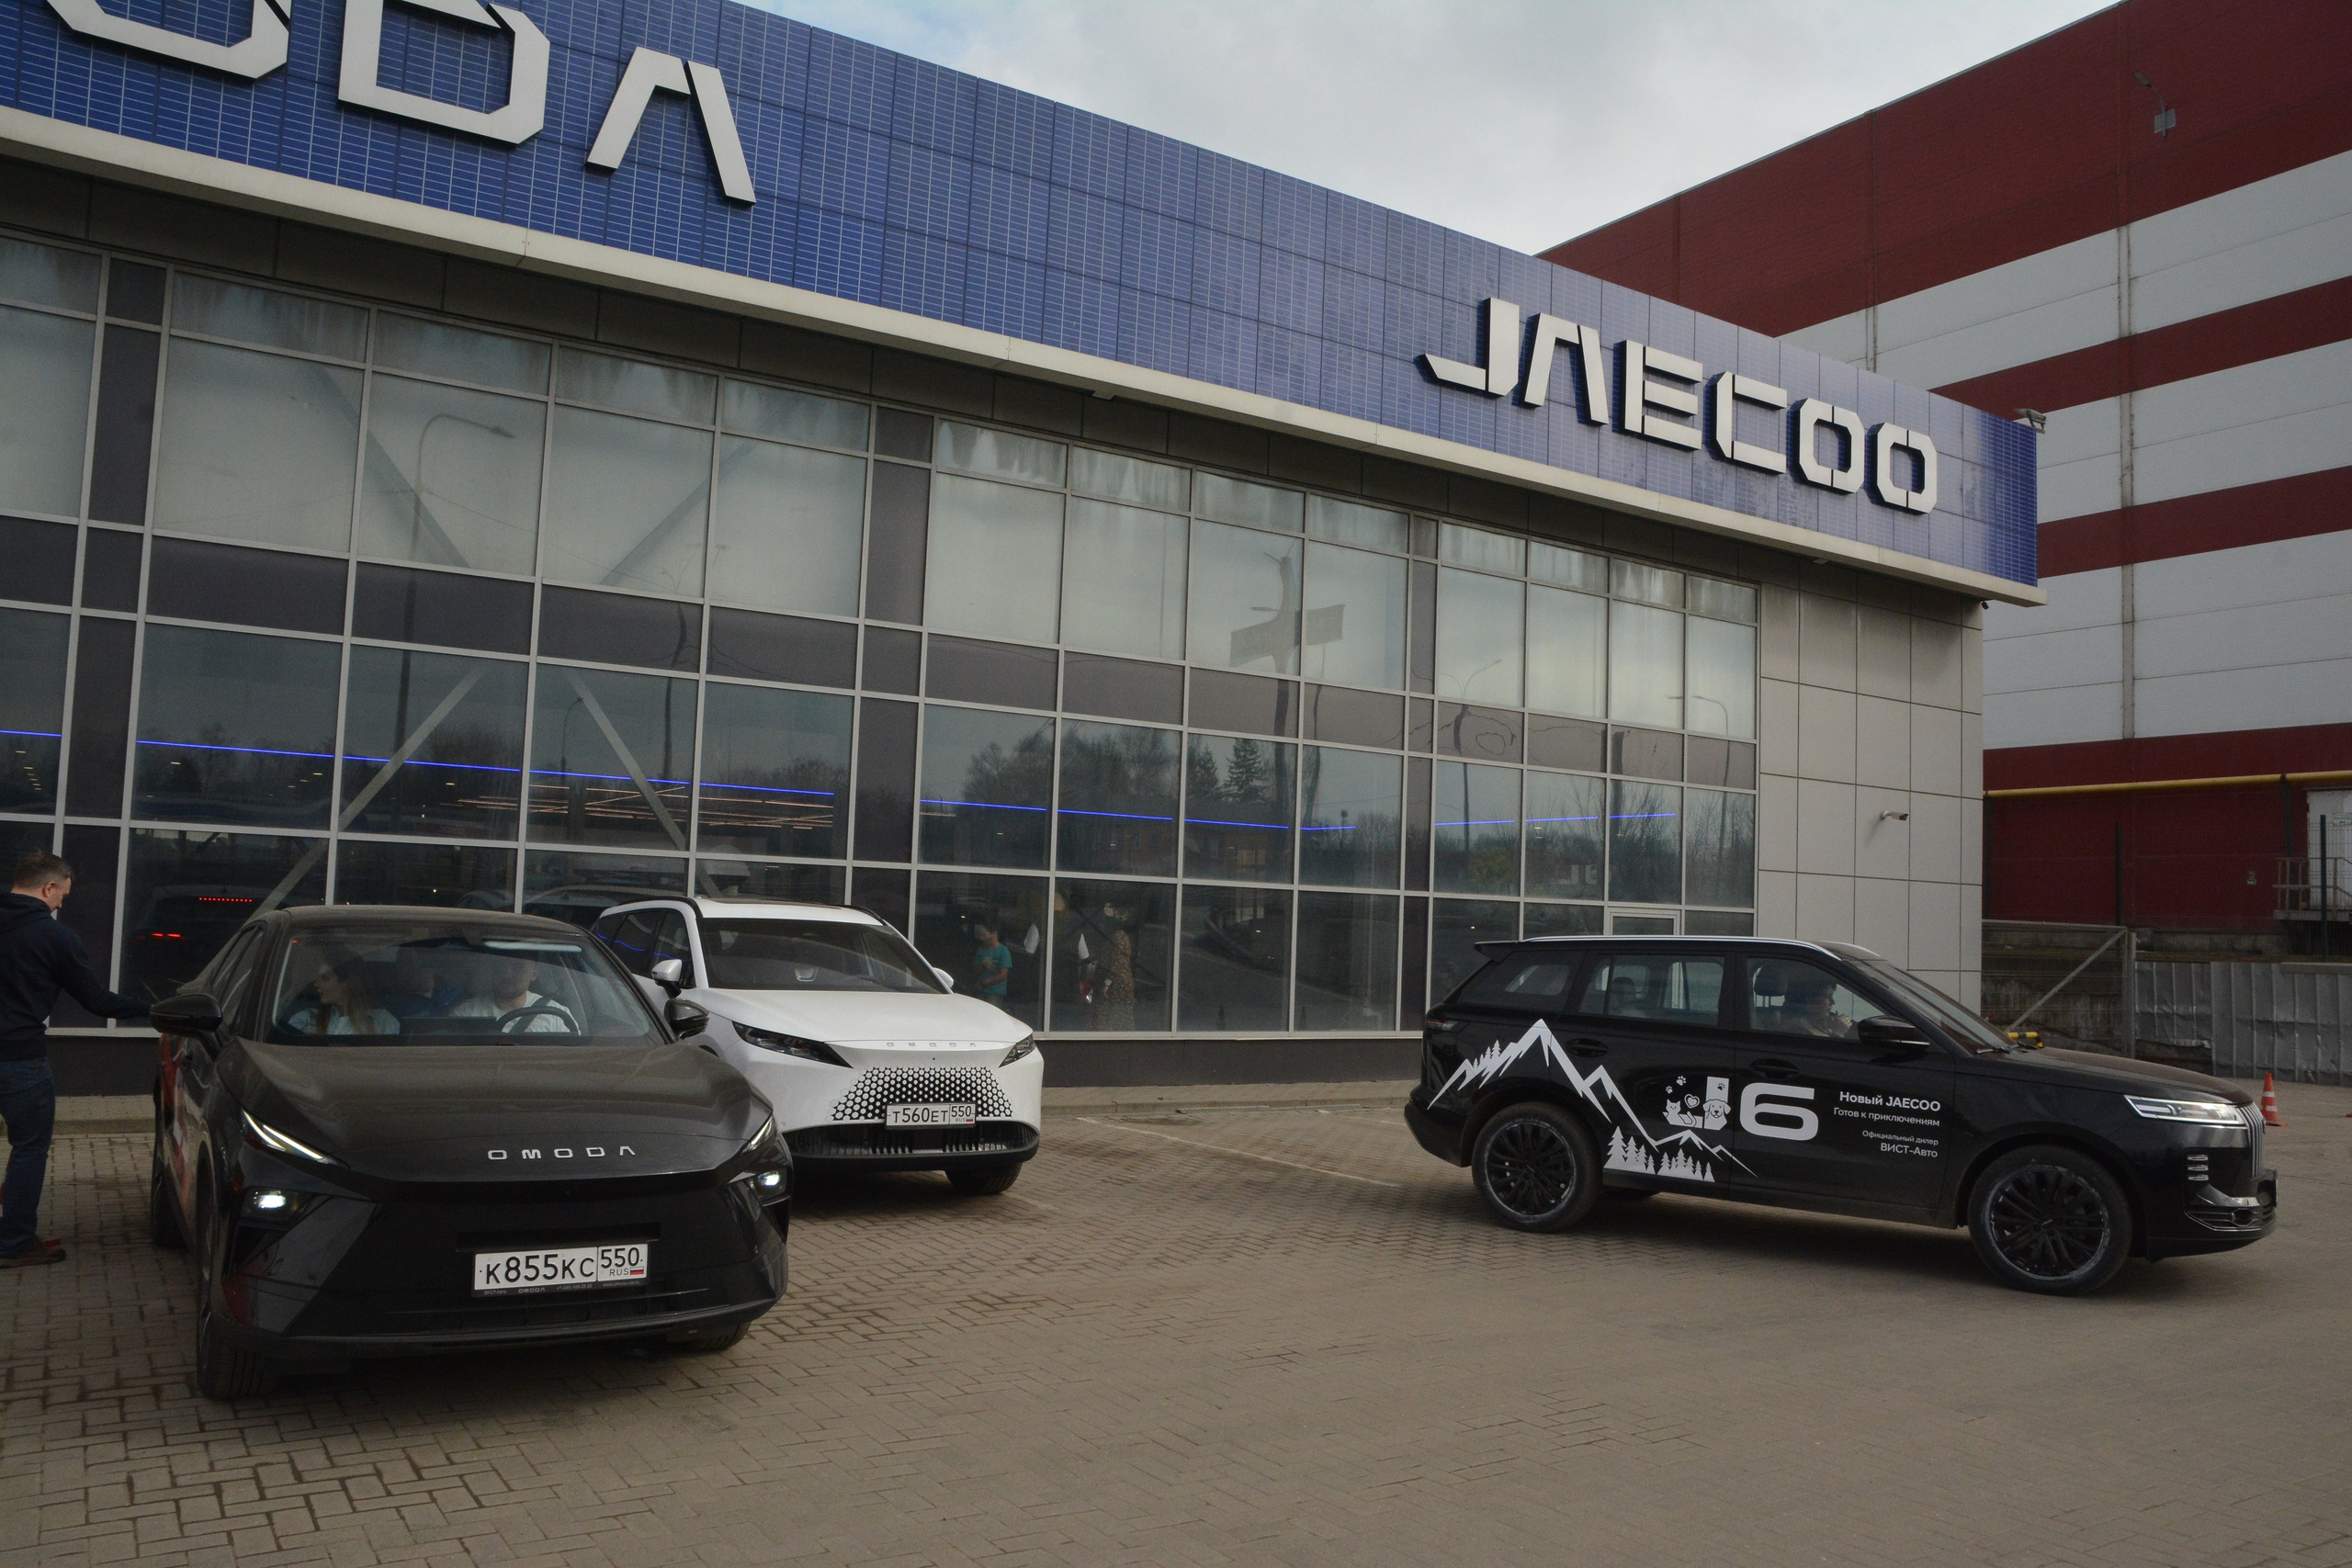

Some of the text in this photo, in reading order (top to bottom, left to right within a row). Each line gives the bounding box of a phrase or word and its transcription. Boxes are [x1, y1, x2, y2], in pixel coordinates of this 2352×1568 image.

[1419, 297, 1938, 514] JAECOO
[1838, 1090, 1940, 1111] Новый JAECOO
[951, 1105, 972, 1117] 550
[1833, 1107, 1860, 1118] Готов
[1868, 1111, 1940, 1127] приключениям
[1861, 1130, 1939, 1147] Официальный дилер
[487, 1145, 636, 1160] OMODA
[1880, 1143, 1939, 1158] ВИСТ-Авто
[600, 1247, 640, 1269] 550
[608, 1267, 629, 1277] RUS
